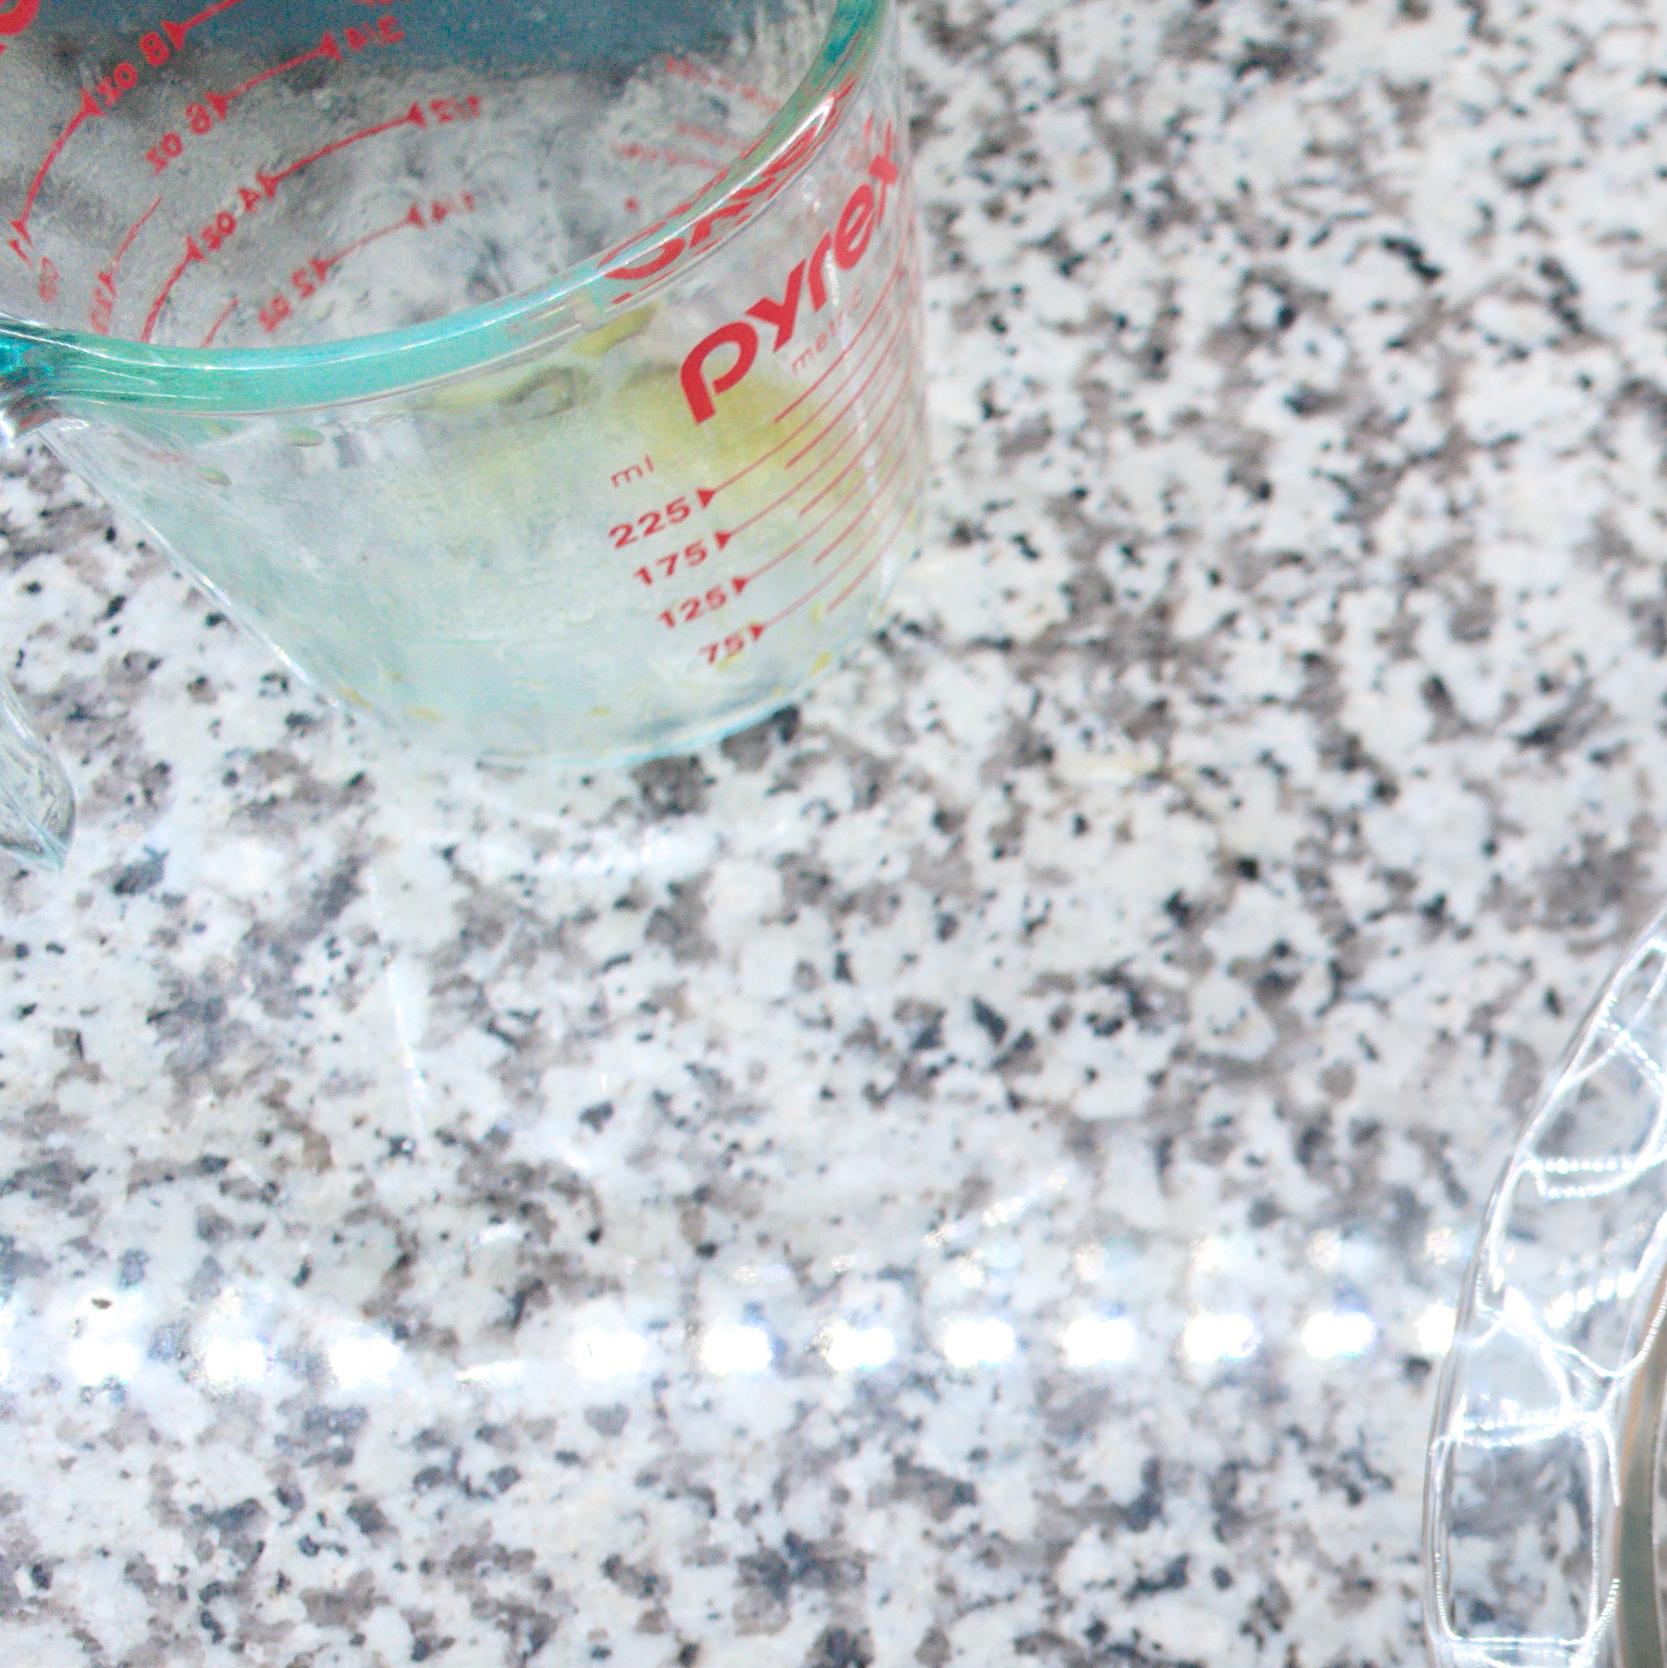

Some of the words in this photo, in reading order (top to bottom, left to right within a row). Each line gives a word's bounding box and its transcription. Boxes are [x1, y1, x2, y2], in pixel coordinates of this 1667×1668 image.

[679, 114, 899, 426] pyrex
[791, 287, 863, 377] metrc
[610, 454, 654, 489] ml
[608, 496, 692, 550] 225
[632, 538, 709, 587] 175
[656, 585, 728, 630] 125
[697, 632, 746, 666] 75
